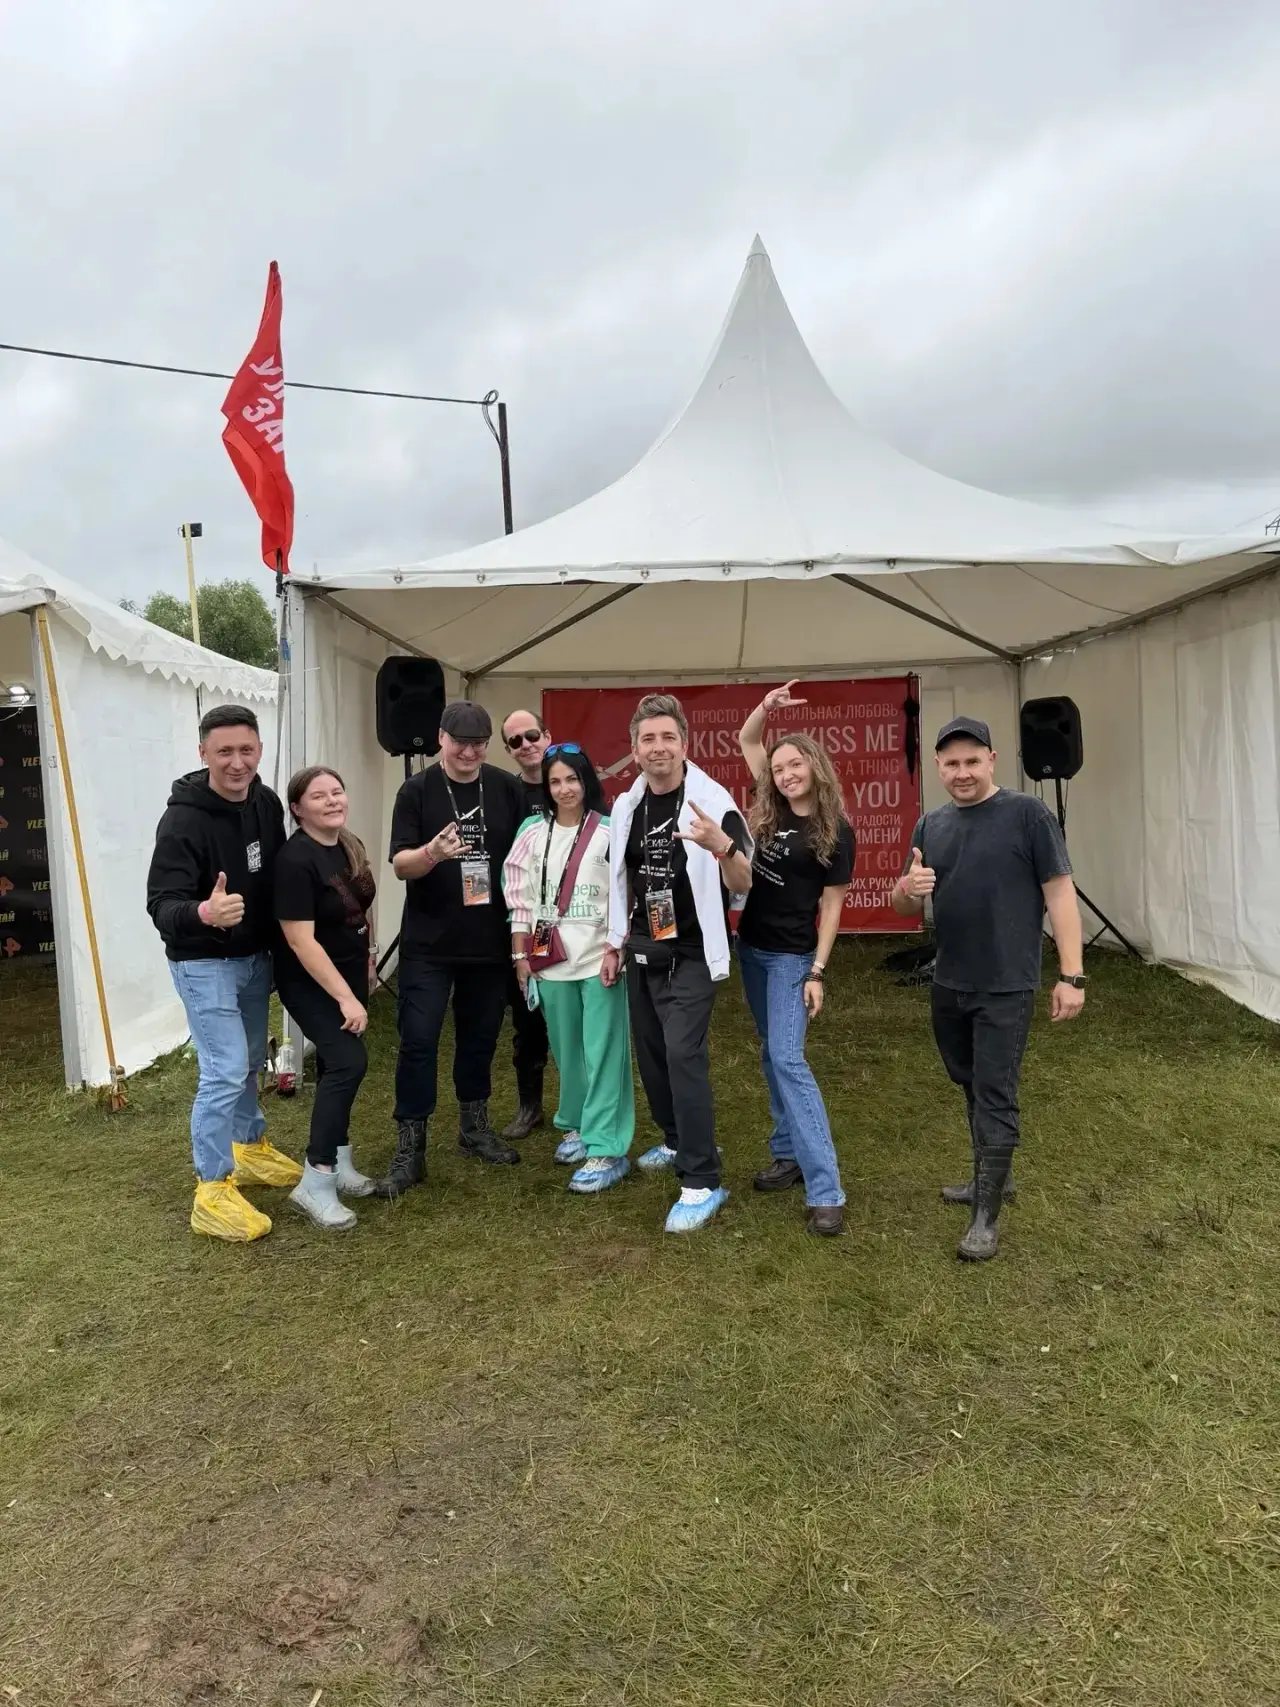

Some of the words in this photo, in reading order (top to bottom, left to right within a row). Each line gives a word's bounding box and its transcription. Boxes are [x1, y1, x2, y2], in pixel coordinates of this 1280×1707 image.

[692, 708, 739, 725] ПРОСТО
[784, 705, 841, 721] СИЛЬНАЯ
[844, 703, 899, 719] ЛЮБОВЬ
[692, 729, 744, 758] KISS
[865, 723, 900, 752] ME
[858, 758, 900, 776] THING
[852, 780, 900, 808] YOU
[876, 850, 901, 870] GO
[845, 891, 893, 908] ЗАБЫТ
